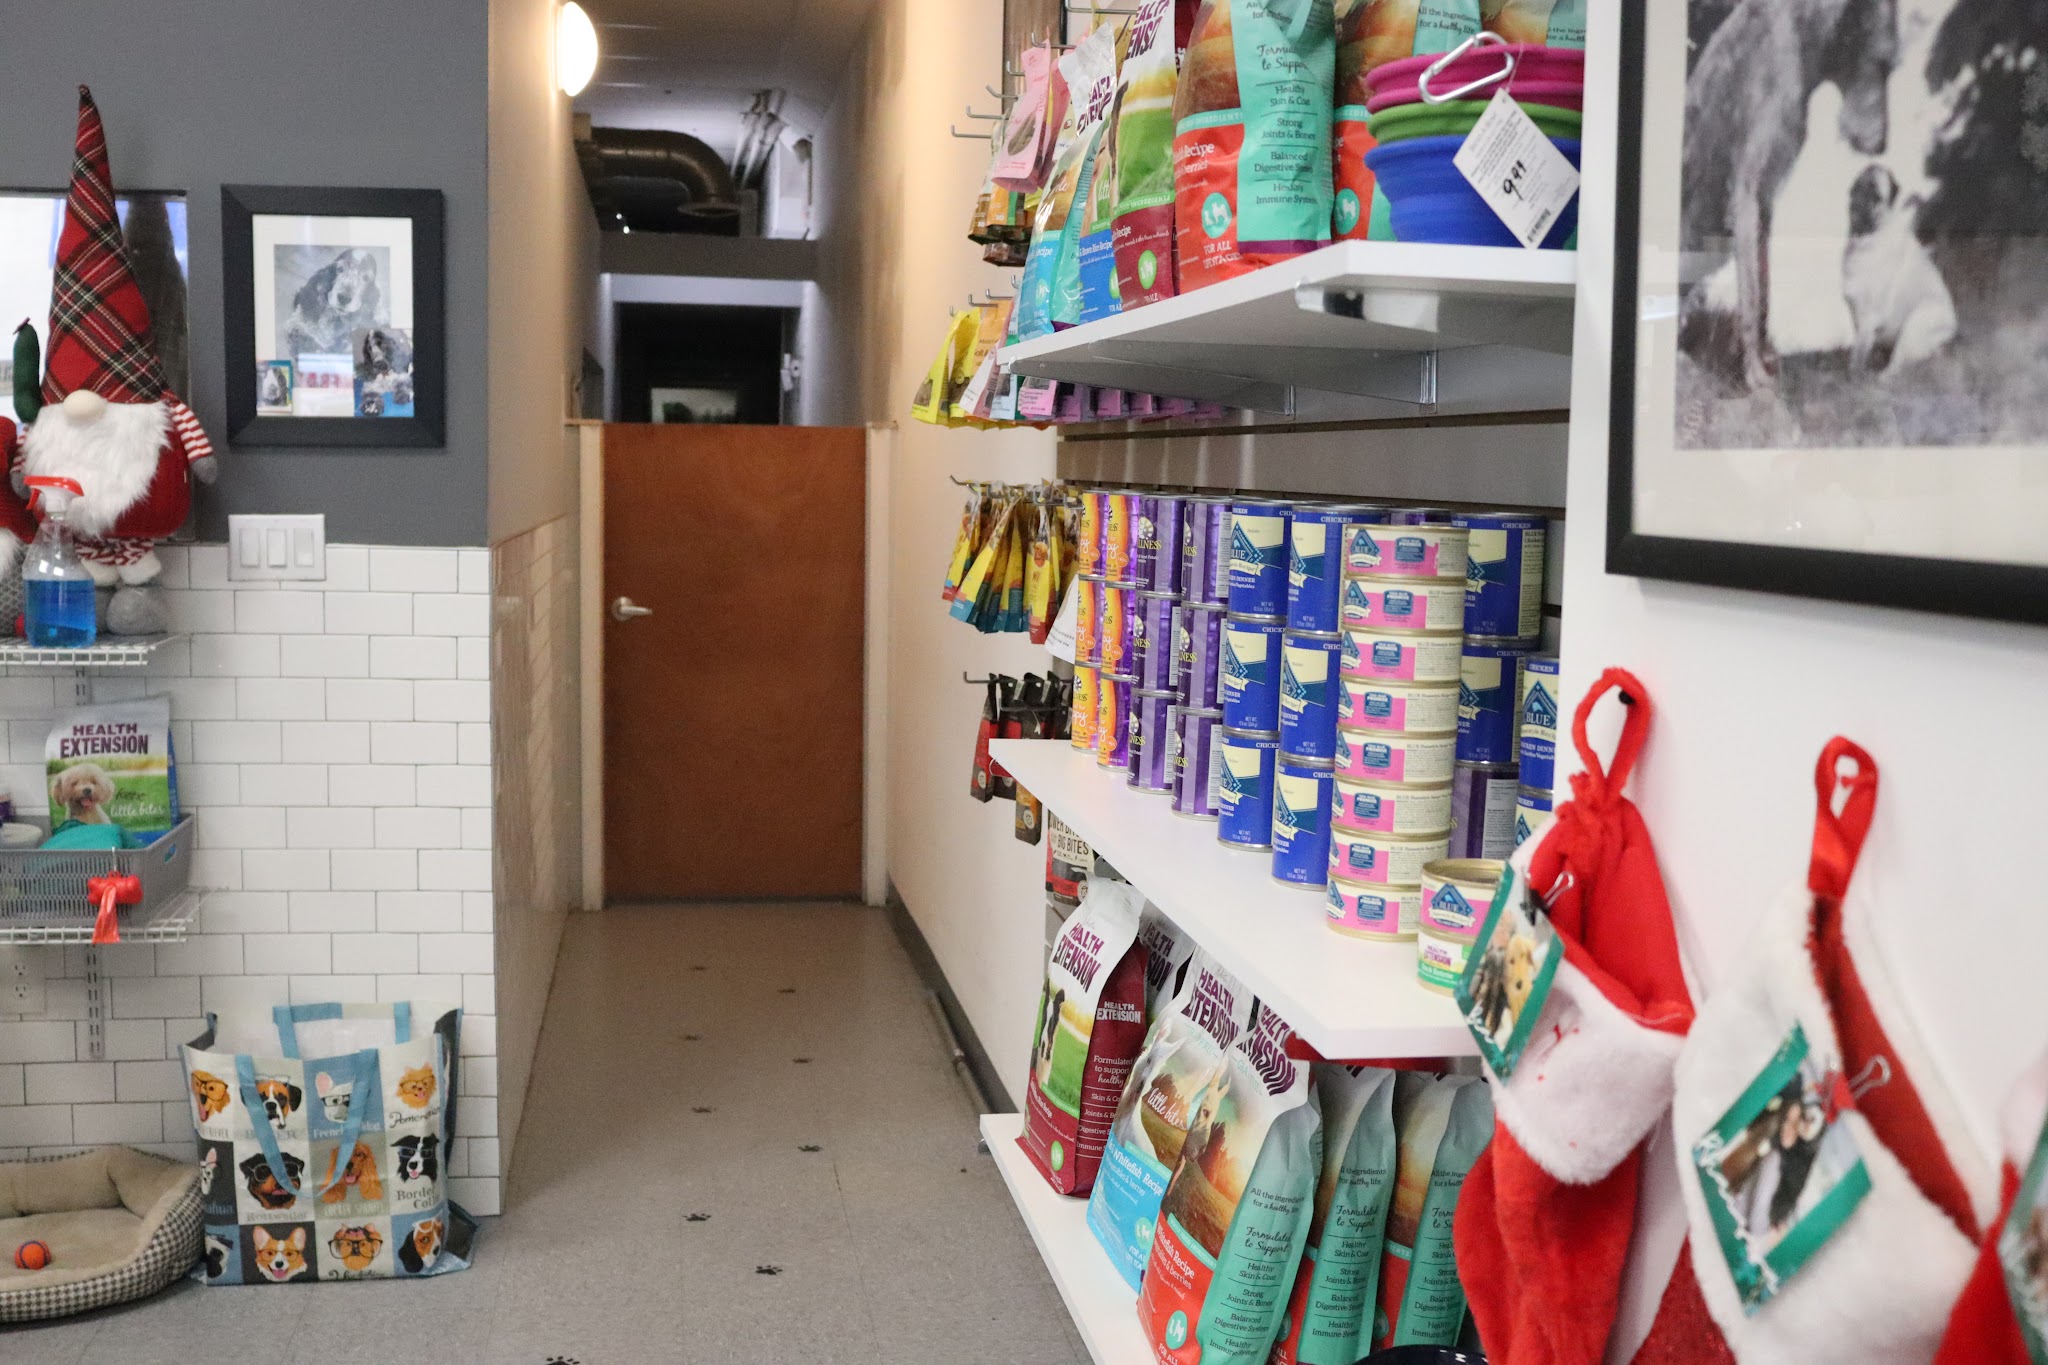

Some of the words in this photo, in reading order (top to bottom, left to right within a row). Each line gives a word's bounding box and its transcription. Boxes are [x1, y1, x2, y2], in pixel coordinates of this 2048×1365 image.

[1429, 8, 1441, 17] the
[1443, 10, 1480, 23] ingredien
[1420, 19, 1432, 28] for
[1262, 58, 1272, 70] to
[1274, 57, 1308, 74] Suppo
[1276, 117, 1304, 130] Strong
[1270, 150, 1309, 162] Balanced
[1216, 239, 1233, 252] ALL
[1278, 509, 1293, 517] CHIC
[1320, 515, 1354, 524] CHICKEN
[1183, 545, 1198, 557] NESS
[1230, 550, 1246, 560] LUE
[1261, 626, 1286, 634] CHICK
[1529, 663, 1554, 673] CHICKEN
[1525, 711, 1551, 726] BLUE
[72, 722, 138, 737] HEALTH
[1540, 729, 1557, 741] Recip
[59, 734, 149, 760] EXTENSION
[1255, 741, 1281, 749] CHICKE
[1536, 744, 1555, 754] DINN
[1174, 757, 1189, 768] NESS
[1312, 771, 1334, 779] CHIC
[110, 803, 136, 817] little
[1057, 834, 1066, 850] BIG
[1066, 837, 1090, 856] BITES
[1068, 921, 1105, 957] HEALTH
[1144, 921, 1175, 958] EALTH
[1052, 933, 1102, 994] EXTENSION
[1199, 966, 1235, 1018] HEALTH
[1103, 1000, 1135, 1011] HEALTH
[1095, 1009, 1141, 1024] EXTENSION
[1259, 1004, 1291, 1049] EALT
[1093, 1054, 1133, 1066] Formulated
[1094, 1065, 1103, 1074] to
[1103, 1066, 1129, 1077] support
[1097, 1074, 1124, 1090] healthy
[1091, 1092, 1106, 1102] Skin
[1147, 1085, 1173, 1120] little
[1084, 1108, 1104, 1119] Joints
[245, 1128, 298, 1141] BER
[1078, 1124, 1108, 1135] Digestive
[1076, 1141, 1102, 1152] Immune
[1113, 1149, 1143, 1180] Whitefish
[1143, 1172, 1164, 1198] Recipe
[1353, 1167, 1387, 1176] gredients
[396, 1189, 432, 1202] Borde
[1250, 1187, 1262, 1198] All
[1262, 1191, 1274, 1201] the
[1252, 1199, 1263, 1208] for
[1269, 1202, 1291, 1215] healthy
[1336, 1216, 1345, 1227] to
[1245, 1225, 1292, 1243] Formulated
[1244, 1238, 1254, 1249] to
[1255, 1240, 1290, 1258] Support
[1334, 1249, 1350, 1258] Skin
[1173, 1248, 1196, 1280] Recipe
[1247, 1262, 1275, 1274] Healthy
[1168, 1264, 1192, 1291] berries
[1238, 1270, 1256, 1281] Skin
[1324, 1275, 1346, 1286] Joints
[1226, 1293, 1249, 1306] Joints
[1241, 1288, 1265, 1300] Strong
[1230, 1312, 1262, 1324] Balanced
[1214, 1316, 1247, 1333] Digestive
